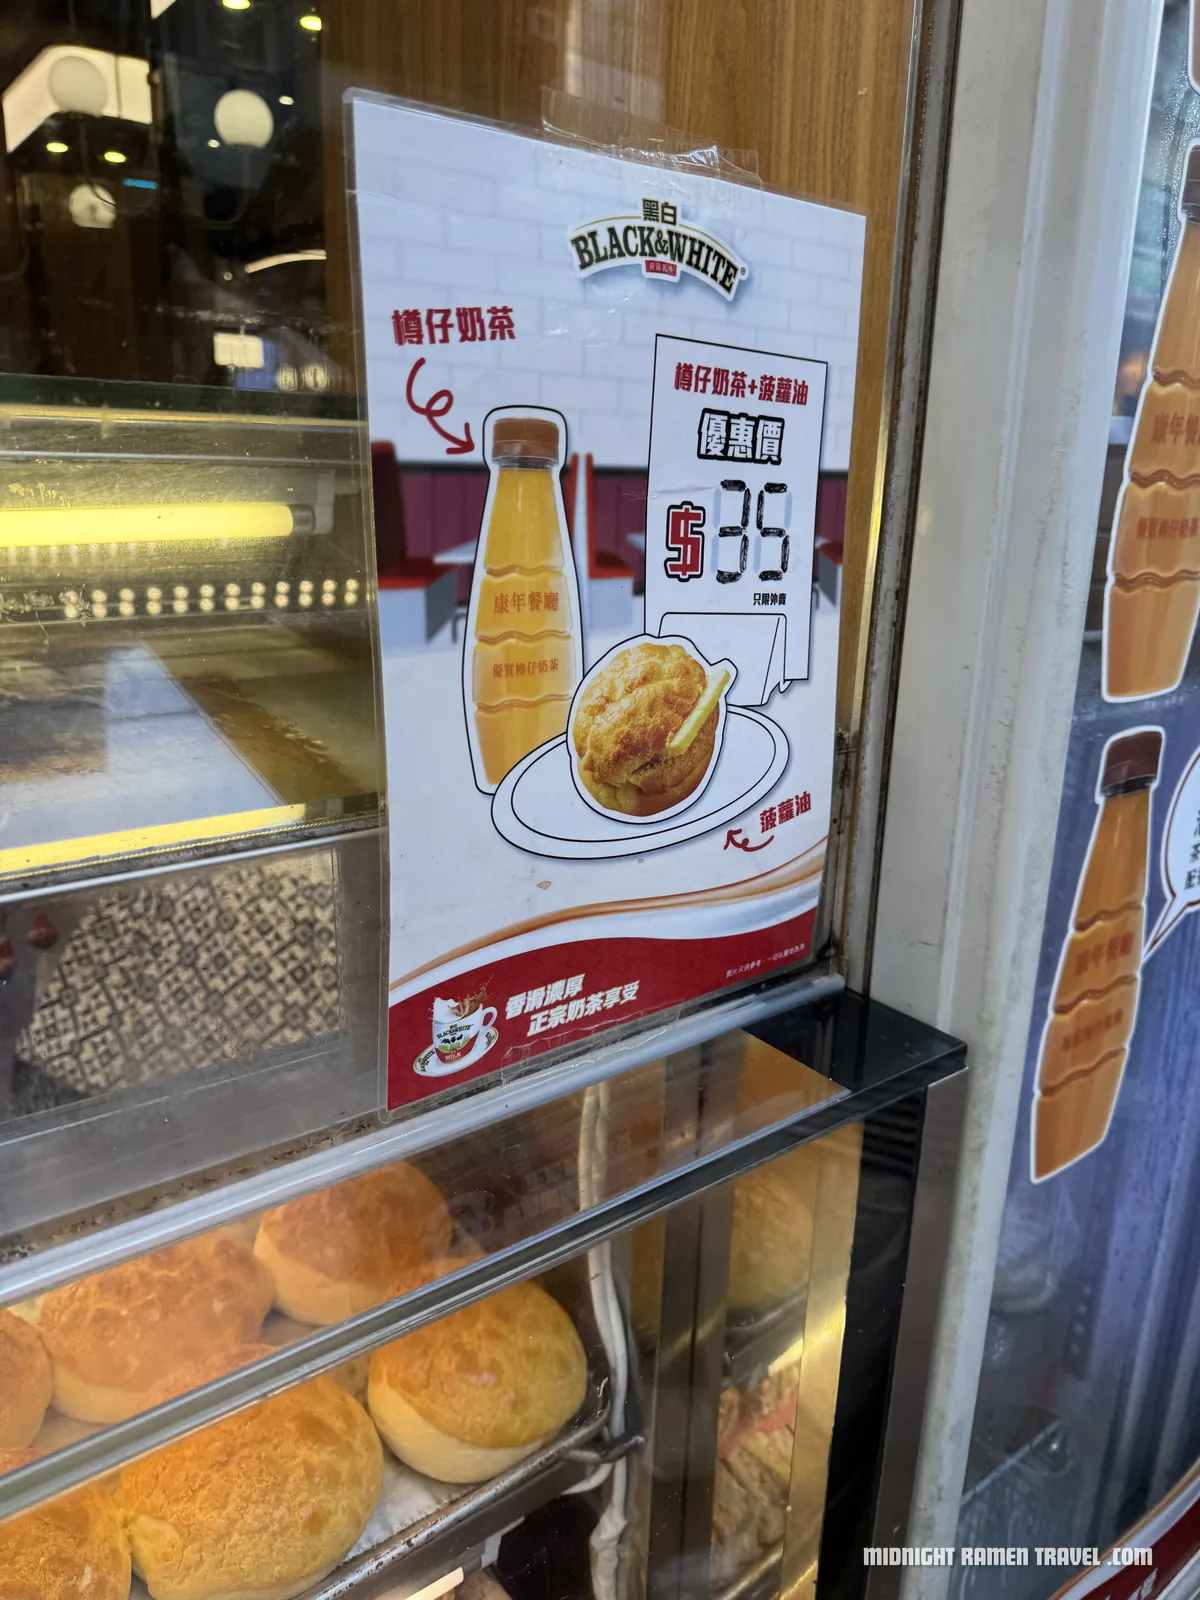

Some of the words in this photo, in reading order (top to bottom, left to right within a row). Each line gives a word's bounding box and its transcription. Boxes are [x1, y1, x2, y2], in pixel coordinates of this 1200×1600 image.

[642, 198, 678, 226] 黑白
[391, 306, 516, 345] 樽仔奶茶
[674, 362, 809, 406] 樽仔奶茶+菠蘿油
[697, 408, 785, 465] 優惠價
[493, 591, 560, 614] 康年餐廳
[752, 592, 787, 606] 只限外賣
[493, 657, 560, 679] 優質樽仔奶茶
[760, 790, 811, 833] 菠蘿油
[505, 973, 586, 1020] 香滑濃厚
[526, 980, 640, 1037] 正宗奶茶享受
